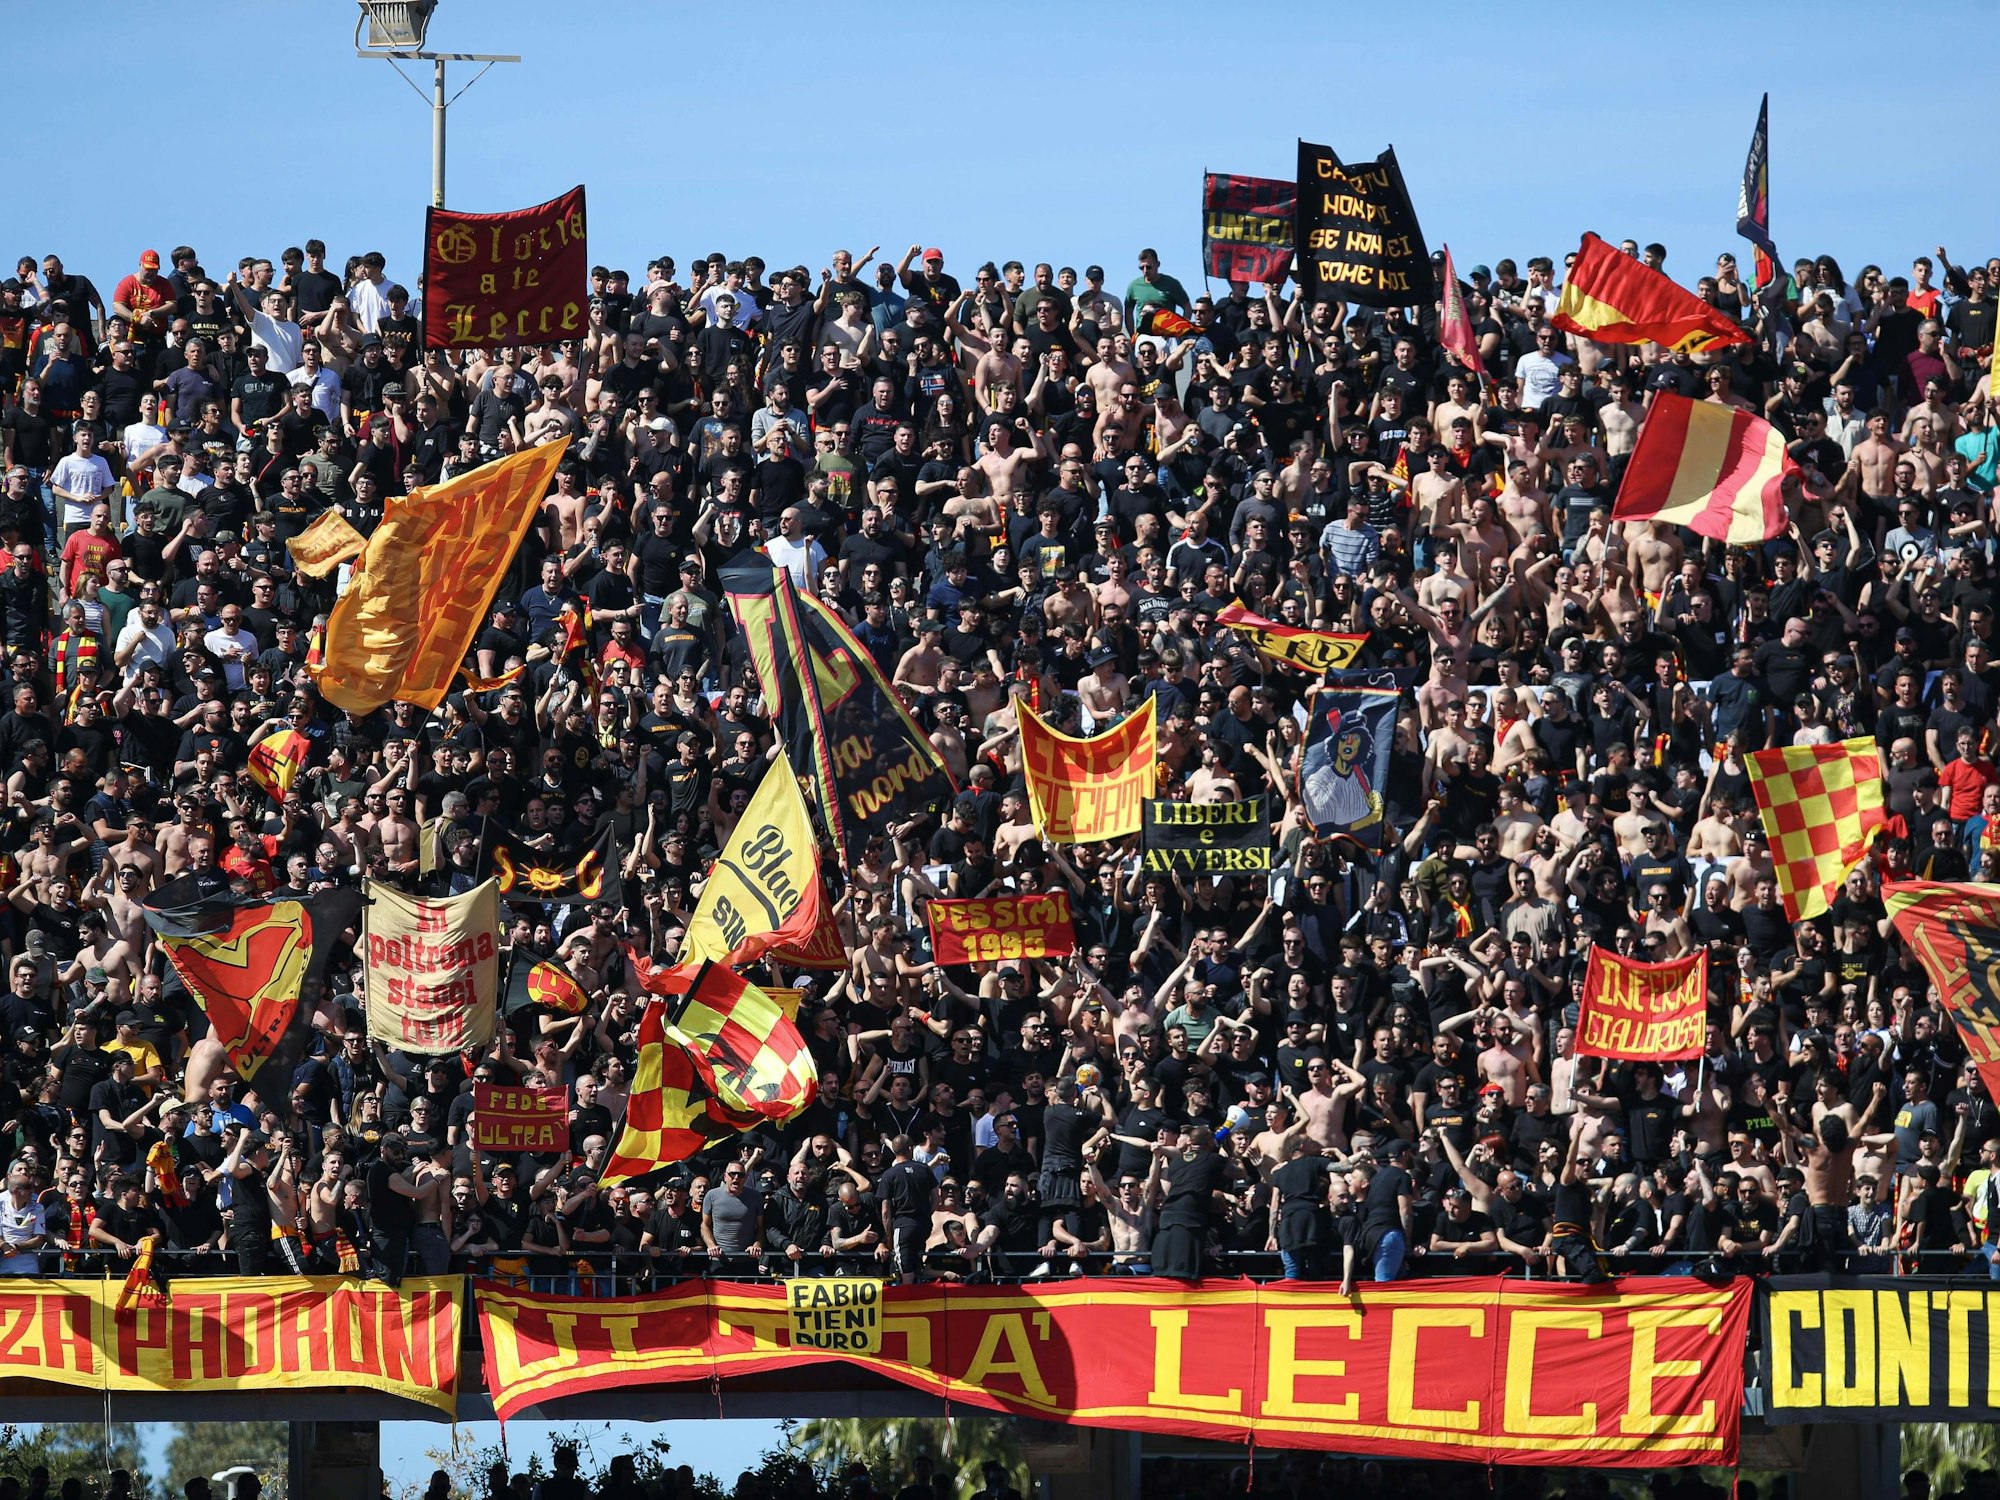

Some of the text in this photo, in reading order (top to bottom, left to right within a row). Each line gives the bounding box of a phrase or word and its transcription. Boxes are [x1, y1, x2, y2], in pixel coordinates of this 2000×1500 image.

[1323, 194, 1366, 219] NON
[437, 212, 585, 264] Gloria
[1207, 211, 1294, 245] UNICA
[1309, 229, 1341, 250] SE
[1345, 231, 1382, 255] NON
[480, 266, 540, 295] a te
[1318, 260, 1411, 291] COME NOI
[445, 301, 581, 344] Lecce
[848, 736, 935, 821] nord
[1153, 800, 1260, 825] LIBERI
[1200, 829, 1215, 844] e
[1140, 847, 1272, 872] AVVERSI
[928, 895, 1069, 932] PESSIMI
[368, 931, 495, 974] poltrona
[961, 929, 1046, 962] 1995
[387, 970, 478, 1010] stacci
[1597, 956, 1704, 1013] INFERNO
[1584, 1009, 1707, 1053] GIALLOROSSO
[793, 1283, 878, 1308] FABIO
[794, 1308, 877, 1331] TIENI
[117, 1289, 456, 1396] PADRONI
[795, 1331, 869, 1350] DURO
[1769, 1288, 2000, 1409] CONT
[1147, 1306, 1723, 1436] LECCE
